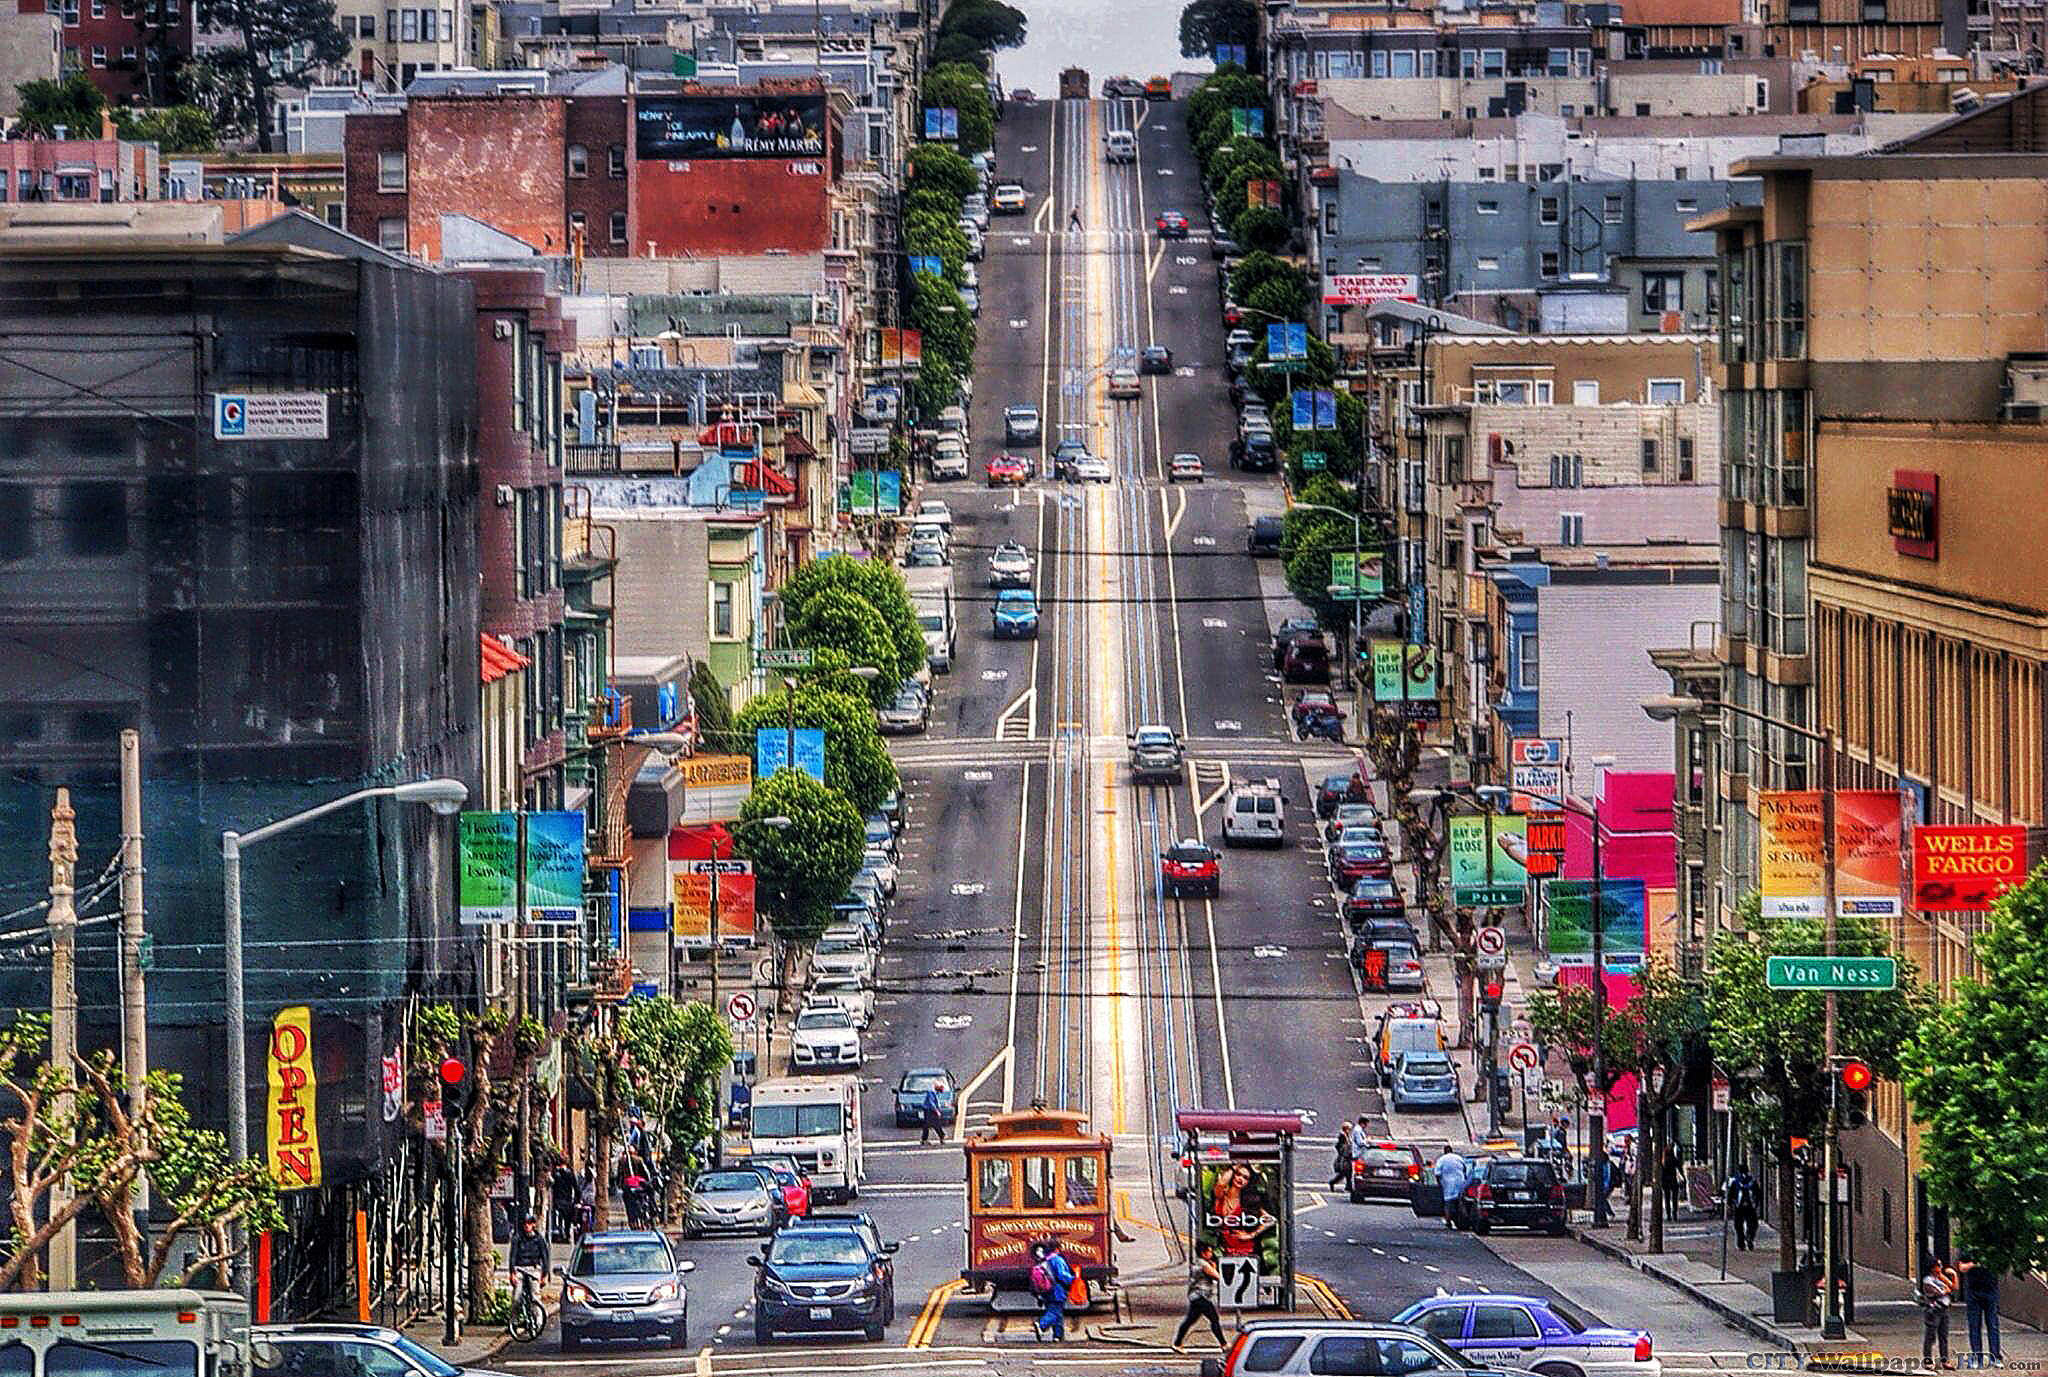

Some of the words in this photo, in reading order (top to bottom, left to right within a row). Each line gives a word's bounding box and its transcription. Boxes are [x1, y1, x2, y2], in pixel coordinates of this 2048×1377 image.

[1332, 277, 1377, 287] TRADER
[1379, 277, 1408, 287] JOE'S
[1452, 827, 1470, 840] BAY
[1472, 827, 1483, 840] UP
[1453, 839, 1483, 852] CLOSE
[1924, 835, 2015, 853] WELLS
[1927, 855, 2015, 874] FARGO
[1471, 891, 1508, 903] Polk
[1783, 965, 1819, 982] Van
[1832, 965, 1881, 982] Ness
[272, 1024, 315, 1185] OPEN
[1205, 1211, 1278, 1229] bebe
[990, 1240, 1026, 1258] Market
[1498, 1350, 1521, 1362] Valley
